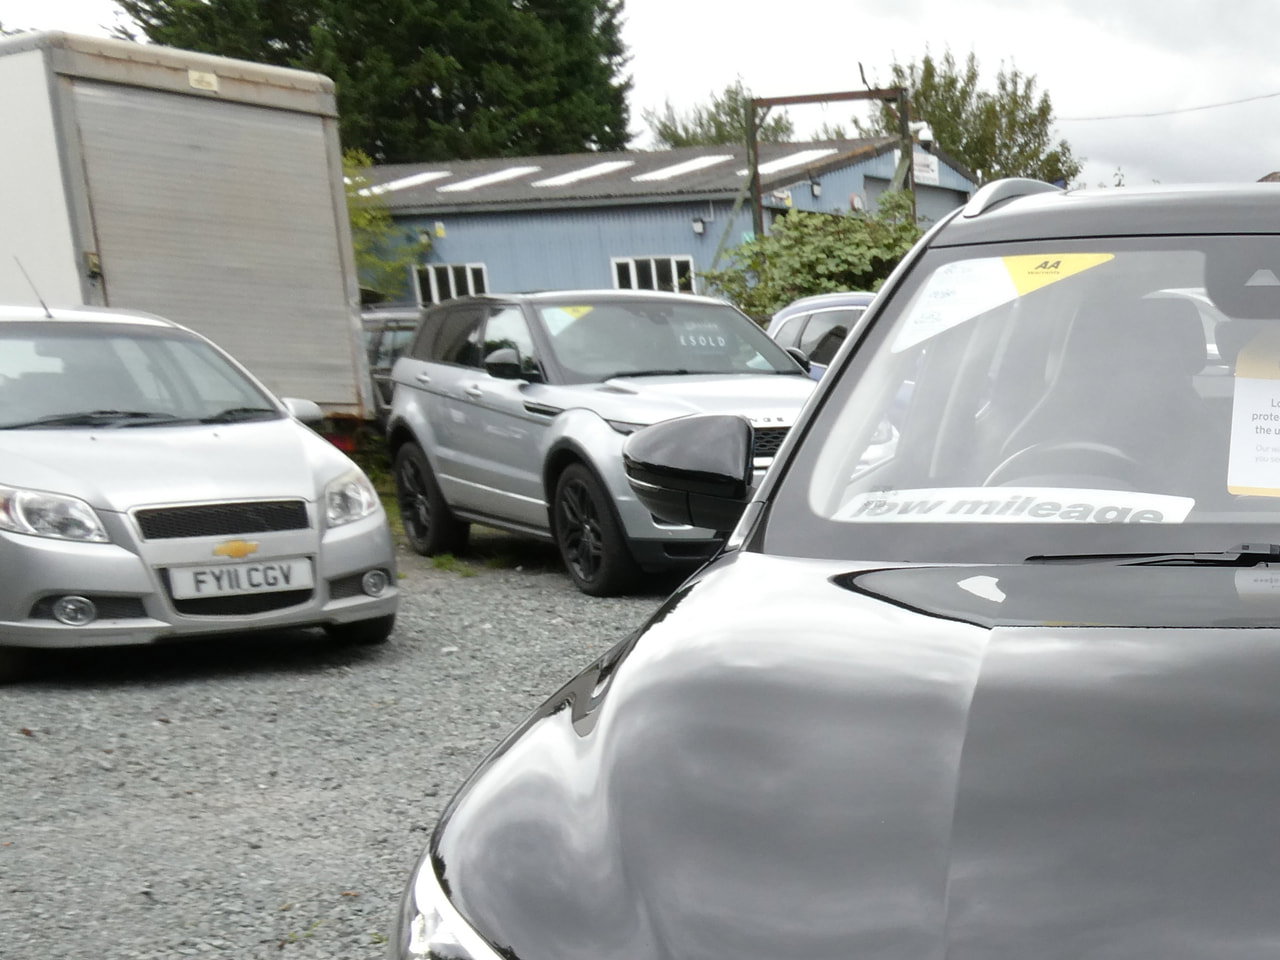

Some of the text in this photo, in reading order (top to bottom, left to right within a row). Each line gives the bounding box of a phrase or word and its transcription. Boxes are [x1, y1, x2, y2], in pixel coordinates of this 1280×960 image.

[1034, 260, 1062, 270] AA
[1255, 426, 1272, 435] the
[1256, 444, 1270, 452] Our
[1255, 455, 1269, 463] you
[949, 495, 1164, 523] mileage
[193, 564, 291, 592] FY11 CGV
